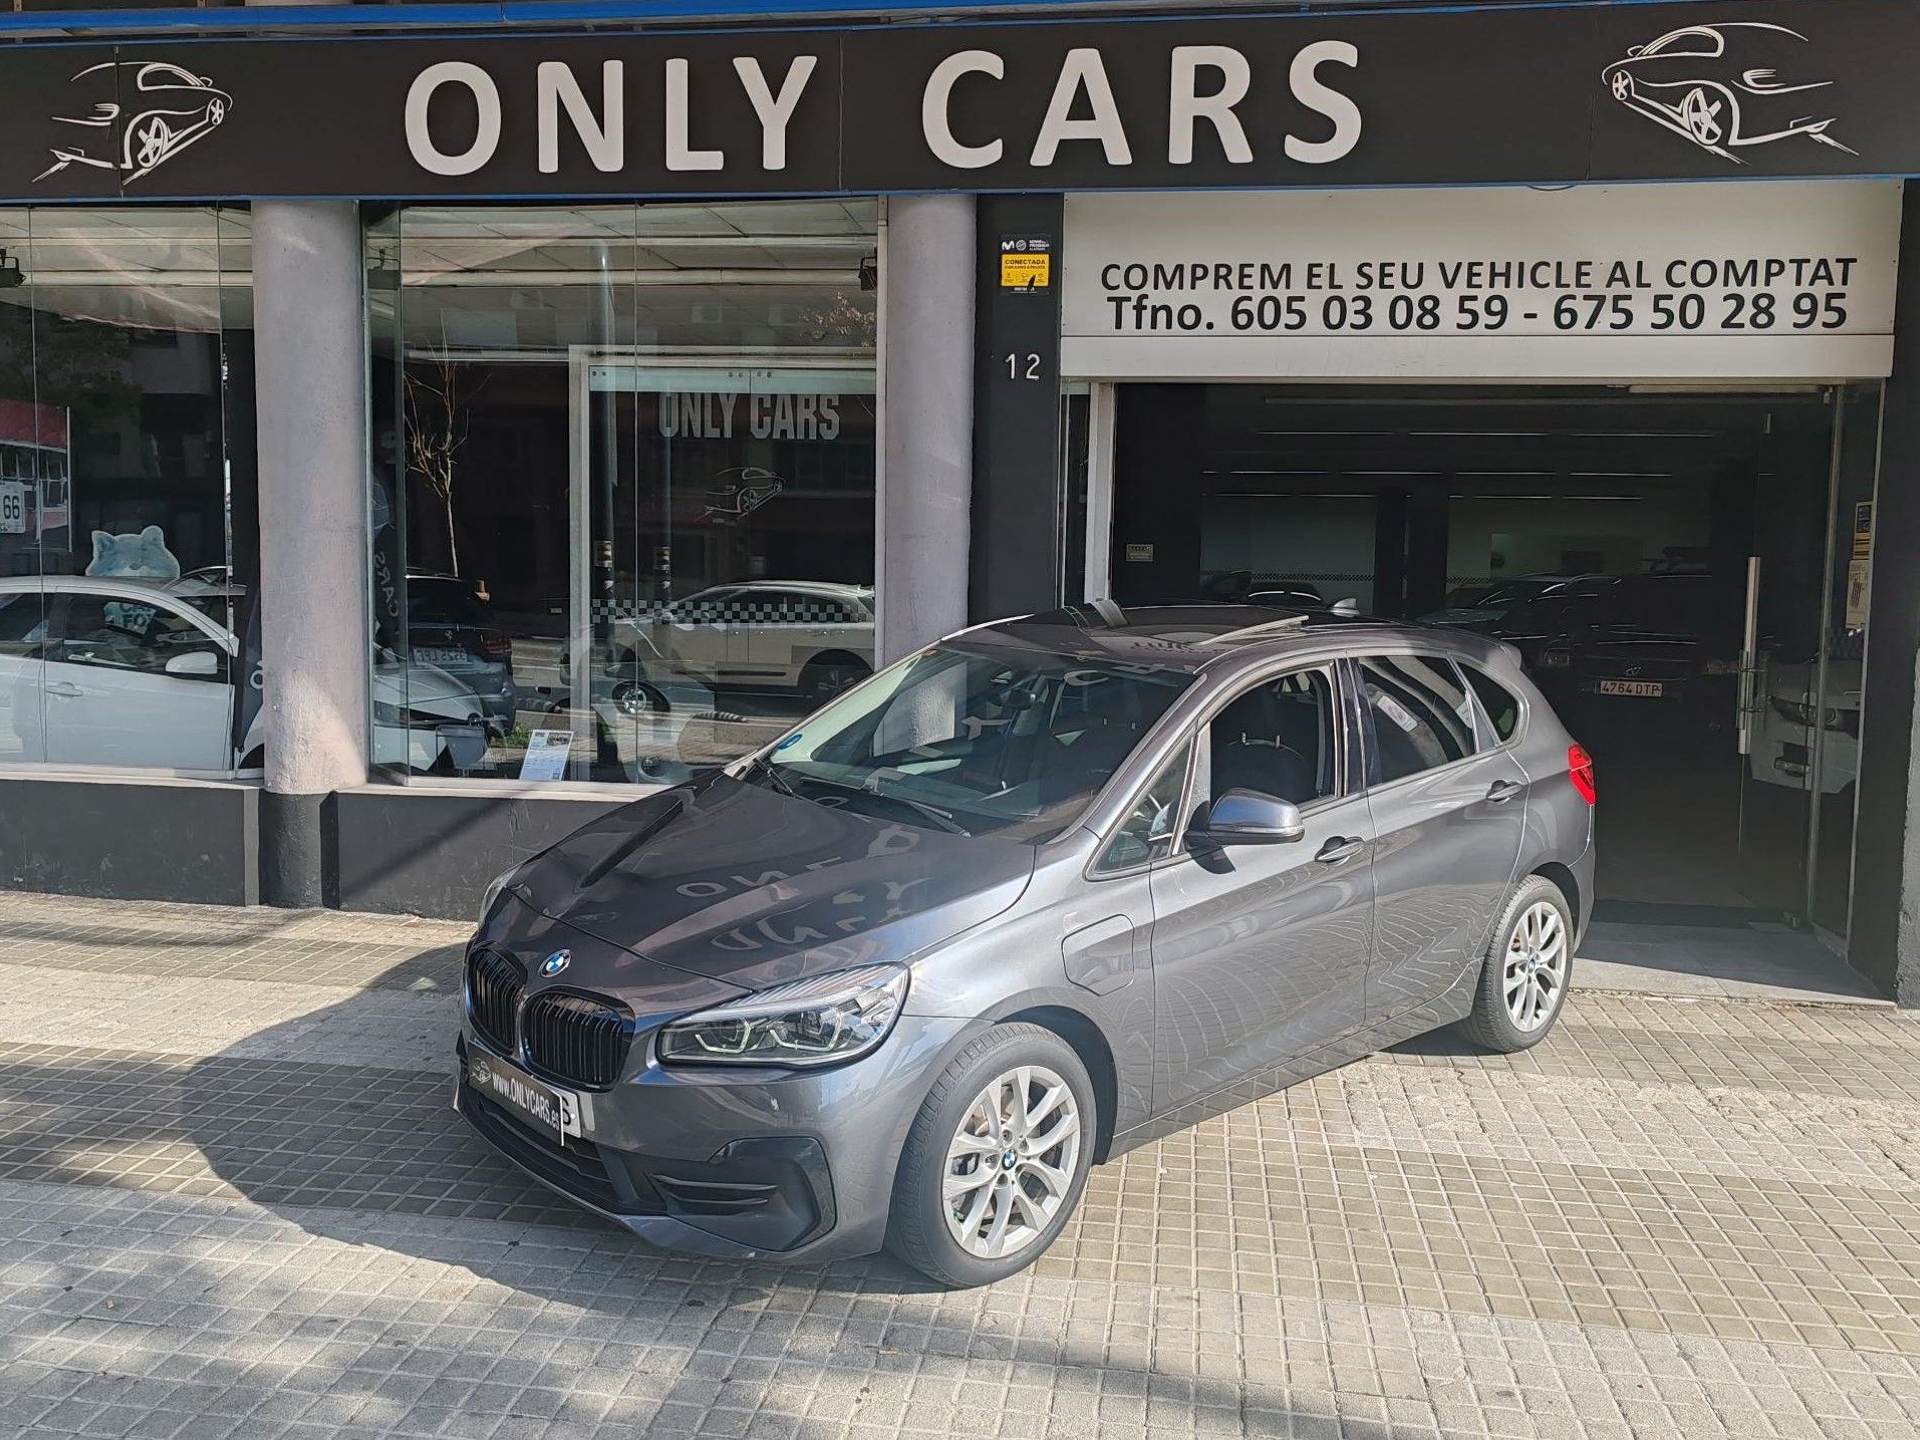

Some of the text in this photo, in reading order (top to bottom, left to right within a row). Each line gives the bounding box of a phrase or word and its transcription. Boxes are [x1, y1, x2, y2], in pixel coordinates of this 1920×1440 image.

[405, 40, 1362, 176] ONLY CARS
[1101, 257, 1858, 291] COMPREM EL SEU VEHICLE AL COMPTAT
[1106, 293, 1214, 331] Tfno.
[1231, 295, 1307, 331] 605
[1322, 294, 1373, 331] 03
[1388, 294, 1441, 331] 08
[1456, 294, 1509, 330] 59
[1553, 293, 1634, 330] 675
[1650, 293, 1705, 330] 50
[1720, 292, 1776, 330] 28
[1792, 292, 1847, 329] 95
[1005, 353, 1040, 380] 12
[658, 392, 840, 440] ONLY CARS
[1602, 682, 1659, 696] 4764 DTP
[492, 1072, 560, 1131] www.ONLYCARS.es
